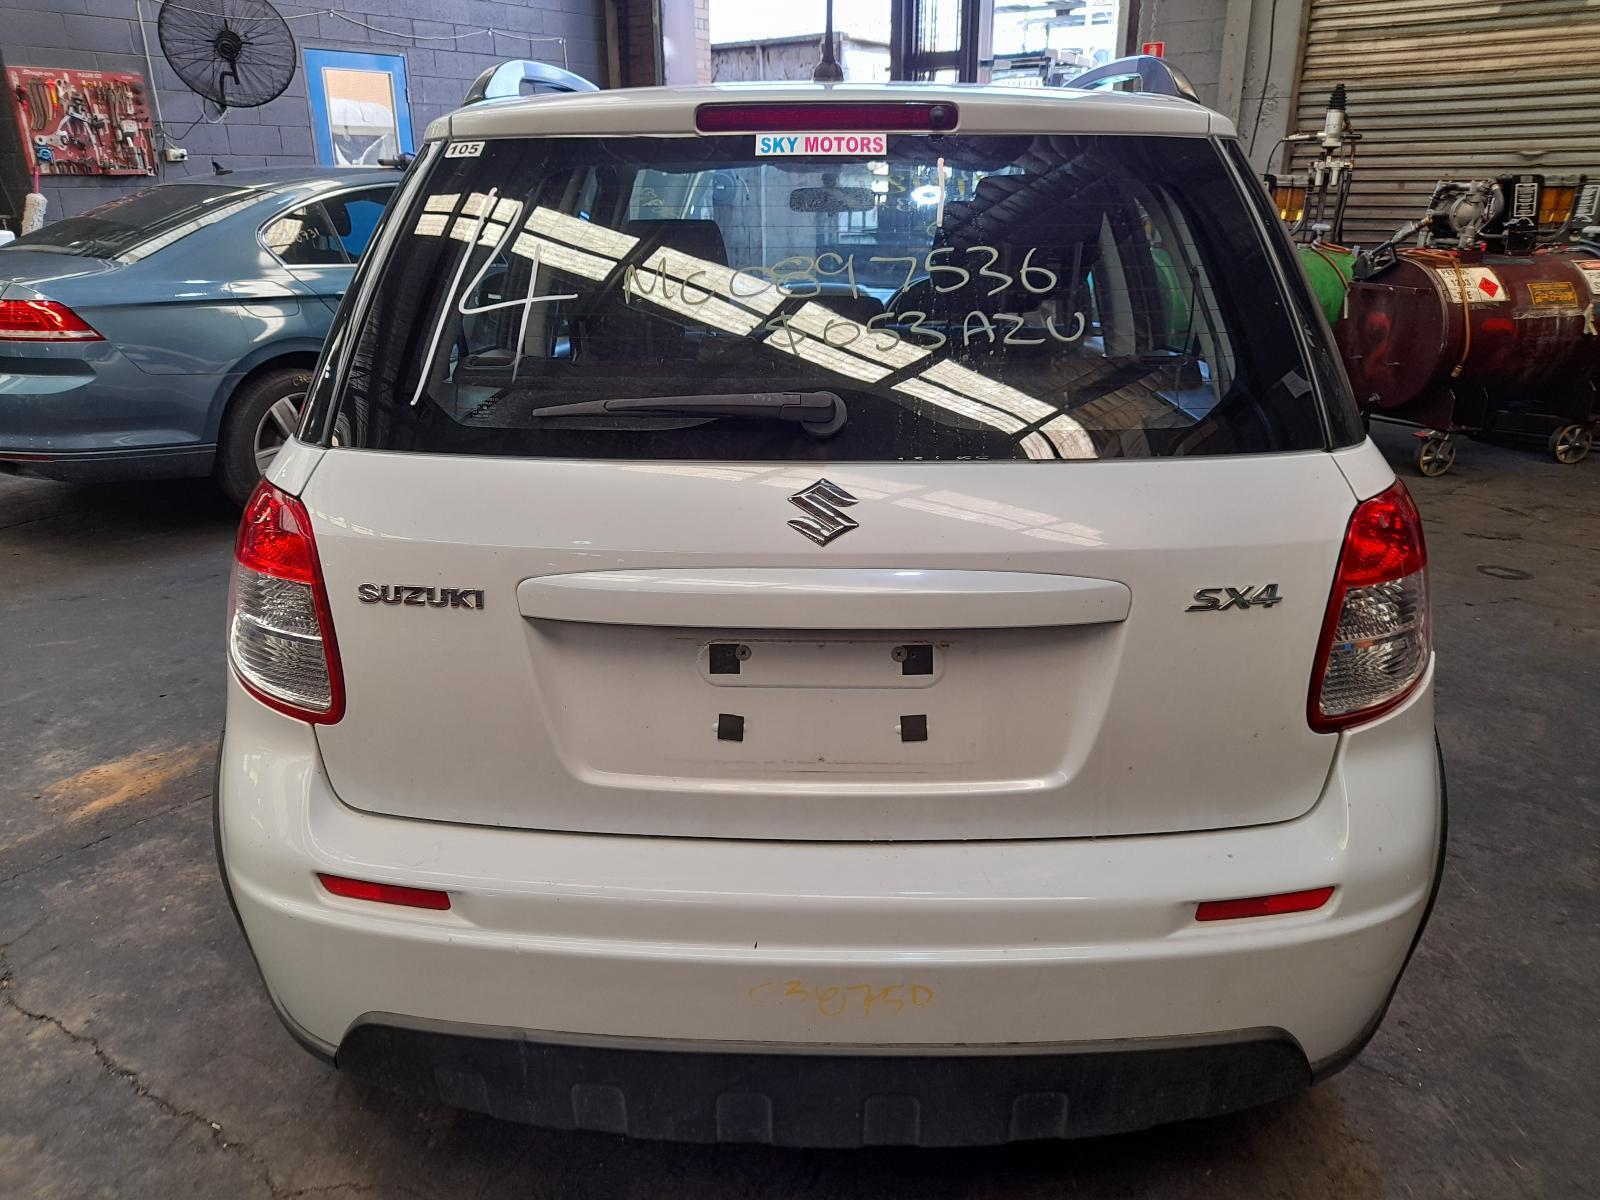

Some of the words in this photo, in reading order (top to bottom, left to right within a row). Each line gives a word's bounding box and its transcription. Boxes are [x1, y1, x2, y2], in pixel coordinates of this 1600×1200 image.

[450, 143, 480, 156] 105
[760, 136, 799, 154] SKY
[804, 136, 884, 153] MOTORS
[358, 582, 485, 610] SUZUKI
[1184, 583, 1283, 612] SX4
